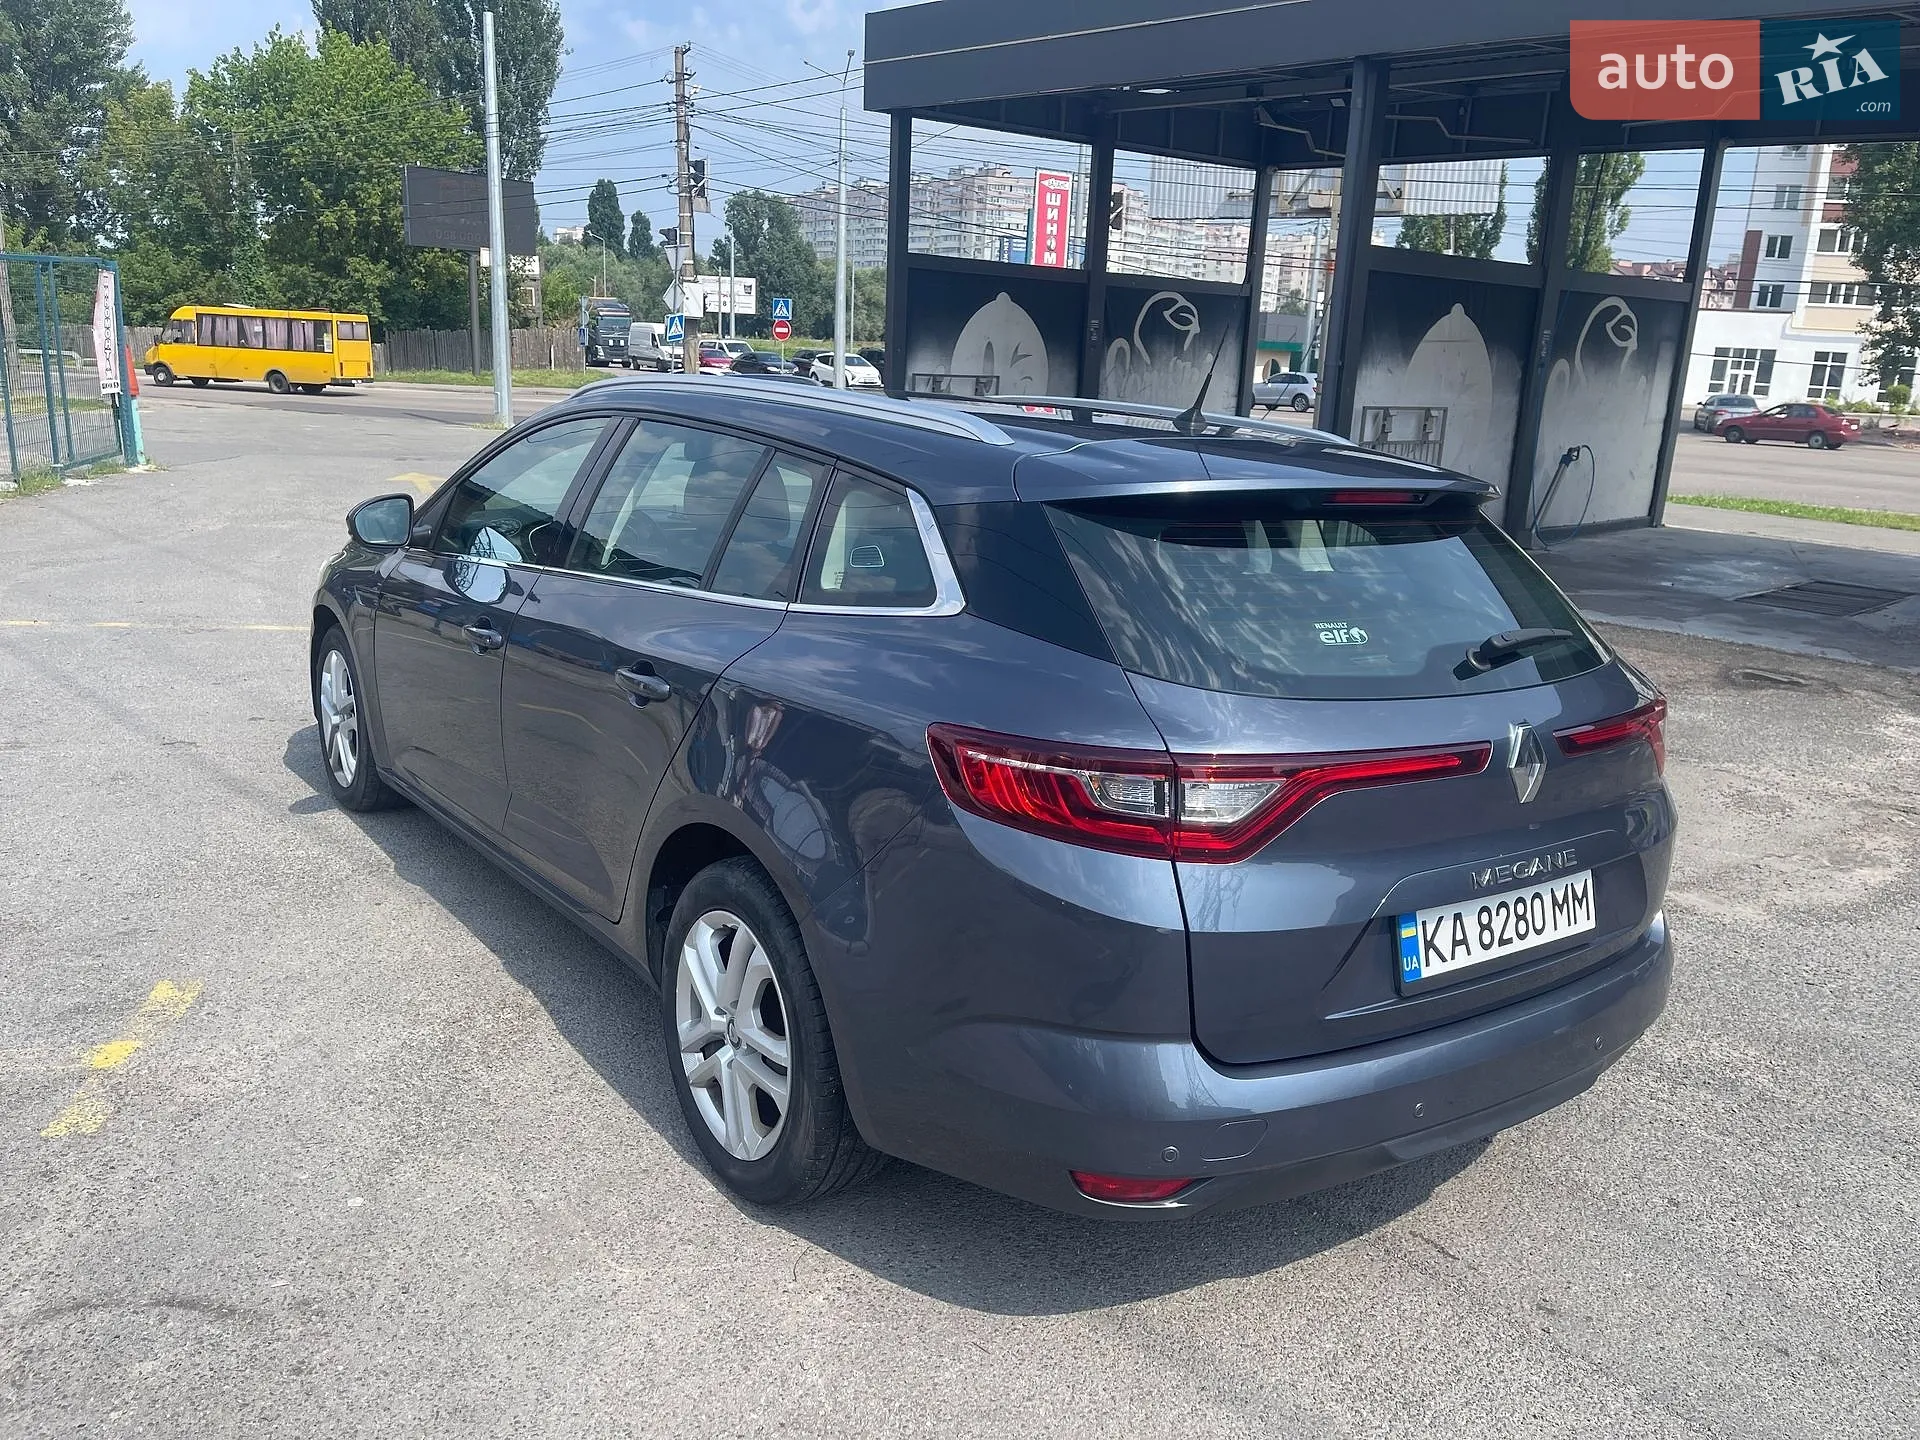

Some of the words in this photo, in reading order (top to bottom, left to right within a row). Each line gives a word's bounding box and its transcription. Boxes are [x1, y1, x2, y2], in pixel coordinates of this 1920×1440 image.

[1471, 849, 1578, 890] MEGANE
[1421, 911, 1472, 968] KA
[1477, 892, 1547, 951] 8280
[1550, 878, 1591, 931] MM
[1403, 958, 1420, 972] UA
